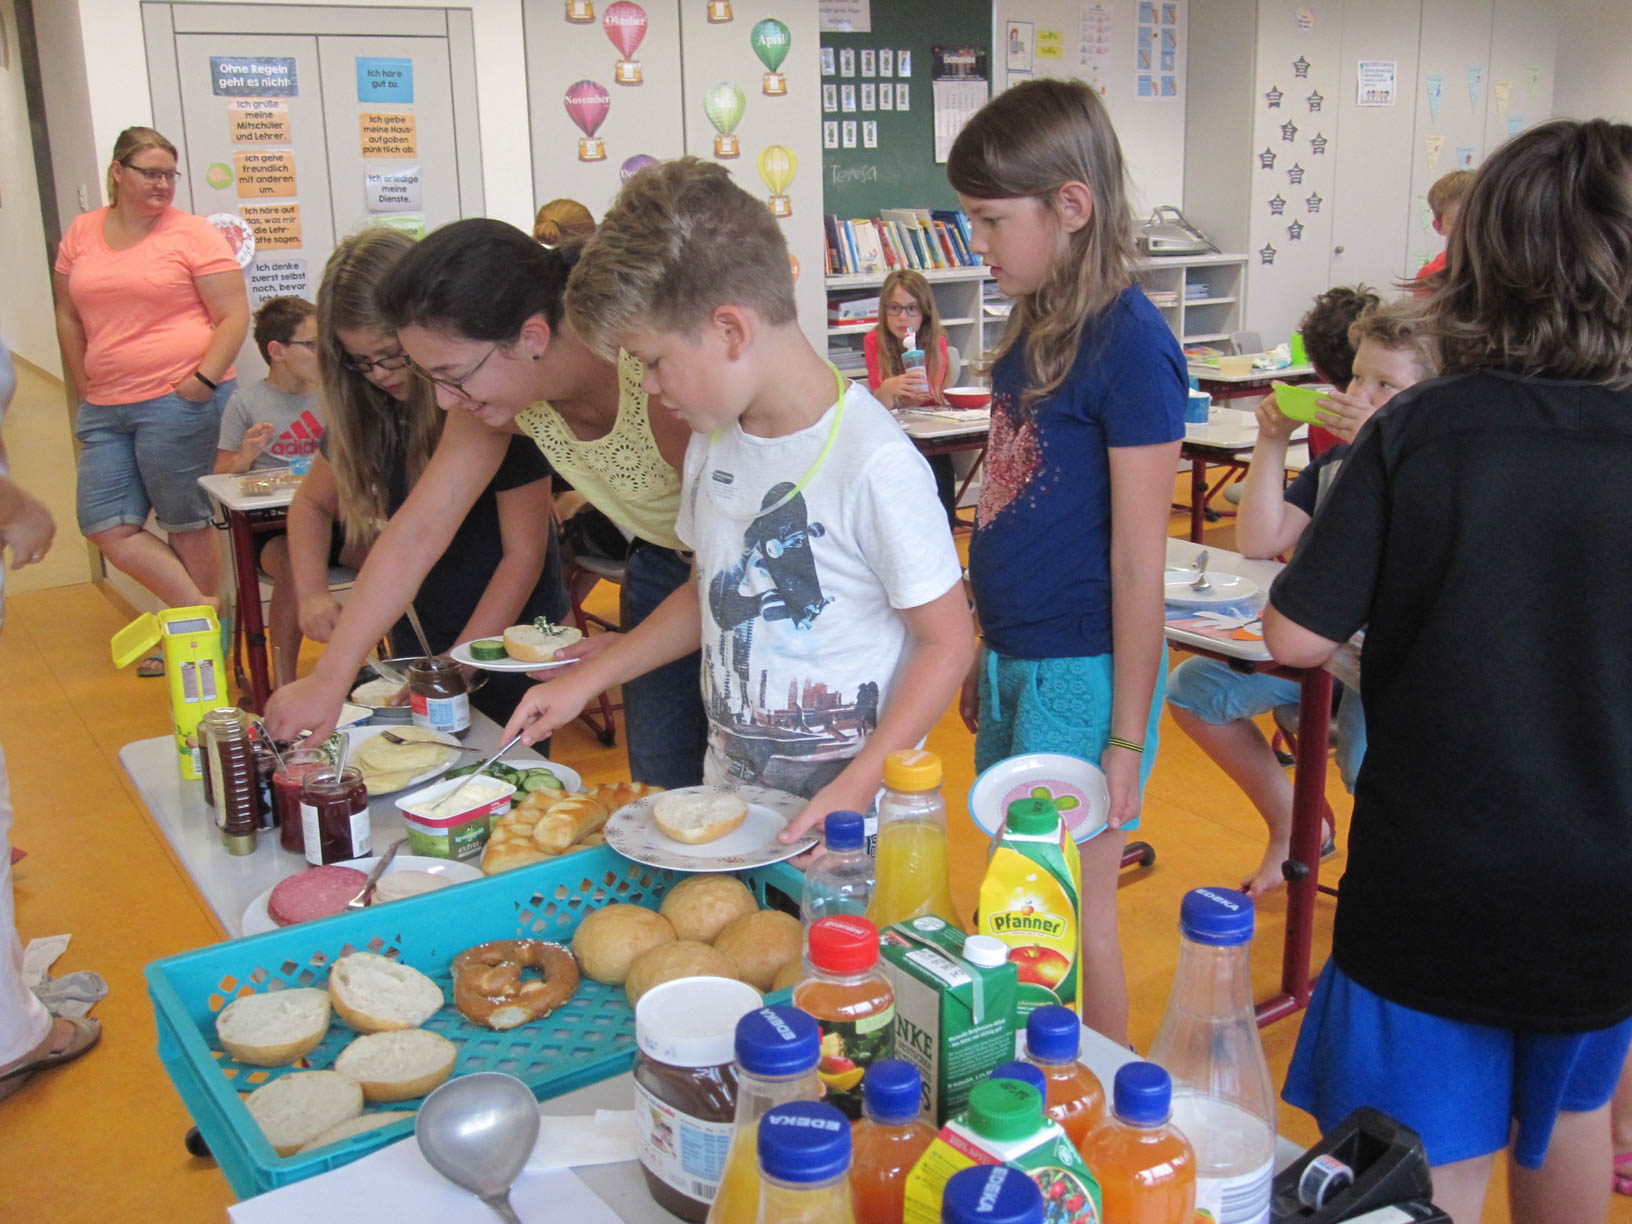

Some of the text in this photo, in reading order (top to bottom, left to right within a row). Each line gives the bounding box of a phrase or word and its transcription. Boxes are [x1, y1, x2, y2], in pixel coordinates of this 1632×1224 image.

[606, 16, 646, 26] Oktober
[758, 33, 786, 48] April
[219, 64, 288, 76] Ohne Regeln
[367, 69, 381, 77] Ich
[219, 77, 244, 88] geht
[247, 79, 260, 87] es
[371, 80, 386, 89] gut
[236, 100, 280, 110] Ich grüße
[565, 95, 612, 105] November
[245, 111, 274, 119] meine
[369, 115, 406, 125] Ich gebe
[236, 121, 284, 130] Mitschüler
[363, 125, 413, 134] meine Haus-
[236, 132, 287, 141] und Lehrer.
[368, 135, 409, 145] aufgaben
[363, 146, 401, 154] pünktlich
[261, 155, 284, 163] gehe
[242, 164, 289, 173] freundlich
[239, 175, 294, 184] mit anderen
[368, 174, 419, 184] Ich erledige
[381, 185, 408, 193] meine
[378, 194, 412, 203] Dienste.
[245, 207, 258, 215] Ich
[281, 206, 295, 214] auf
[283, 216, 297, 224] mir
[254, 225, 290, 234] die Lehr-
[256, 262, 300, 272] Ich denke
[251, 272, 306, 283] zuerst selbst
[279, 283, 306, 292] bevor
[271, 439, 320, 456] adid
[1195, 888, 1240, 911] EDEKA
[994, 912, 1061, 934] Pfanner
[759, 1007, 797, 1041] EDEKA
[768, 1115, 841, 1132] EDEKA
[976, 1166, 1009, 1212] EDEKA
